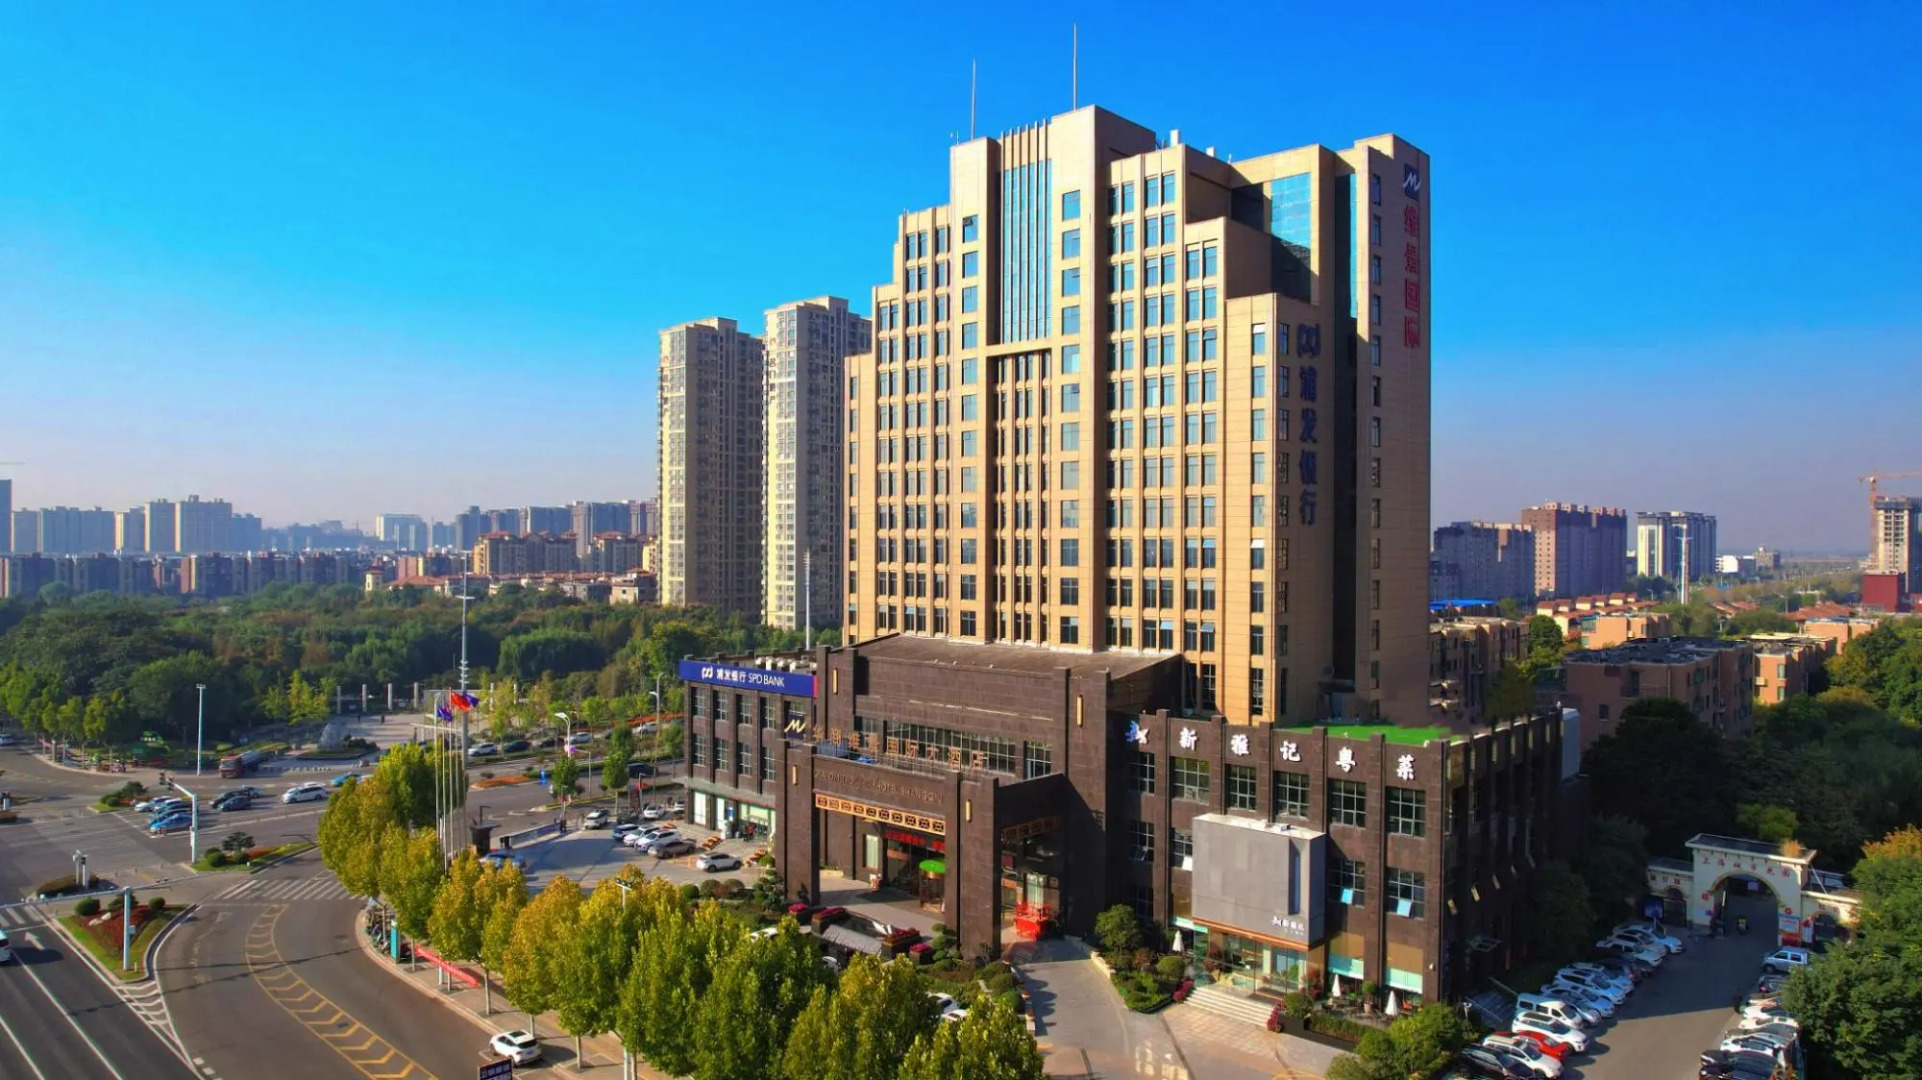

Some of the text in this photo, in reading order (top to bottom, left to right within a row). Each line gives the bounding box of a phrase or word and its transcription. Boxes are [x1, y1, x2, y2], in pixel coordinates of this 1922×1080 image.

[1298, 365, 1319, 526] 浦发银行
[716, 667, 785, 688] 浦发银行 SPD BANK
